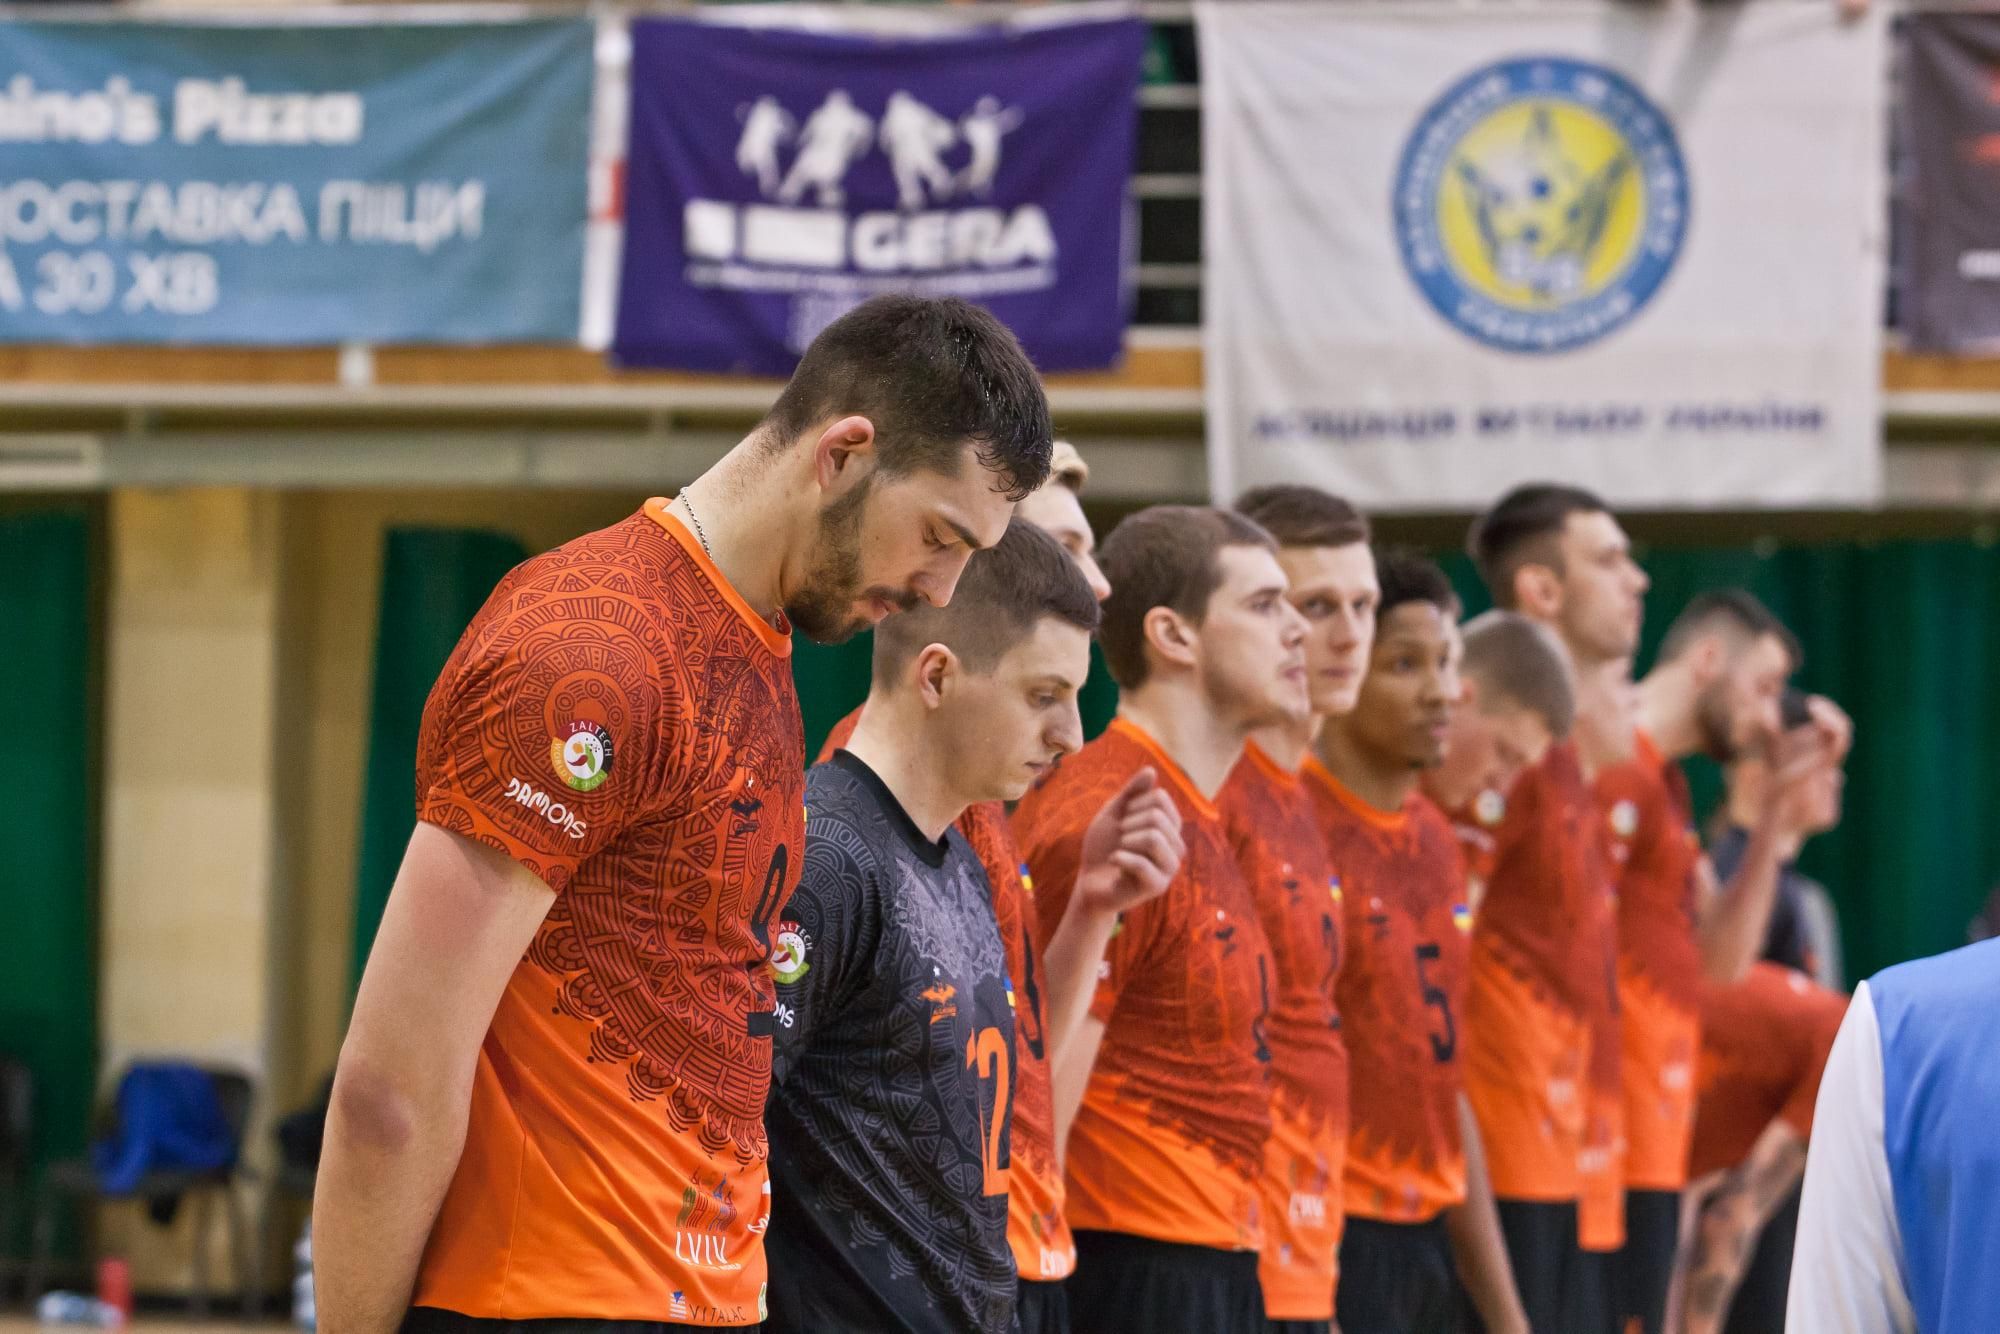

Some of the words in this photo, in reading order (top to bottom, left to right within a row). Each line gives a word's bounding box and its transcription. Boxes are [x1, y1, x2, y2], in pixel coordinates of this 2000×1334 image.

[0, 73, 160, 146] ino's
[174, 77, 364, 146] Pizza
[0, 179, 308, 246] ОСТАВКА
[34, 250, 116, 316] 30
[122, 250, 218, 316] ХВ
[569, 720, 613, 757] ZALTECH
[780, 922, 814, 951] ALTECH
[1414, 944, 1456, 1063] 5
[675, 1231, 728, 1266] LVIV
[689, 1304, 747, 1323] VITALAC
